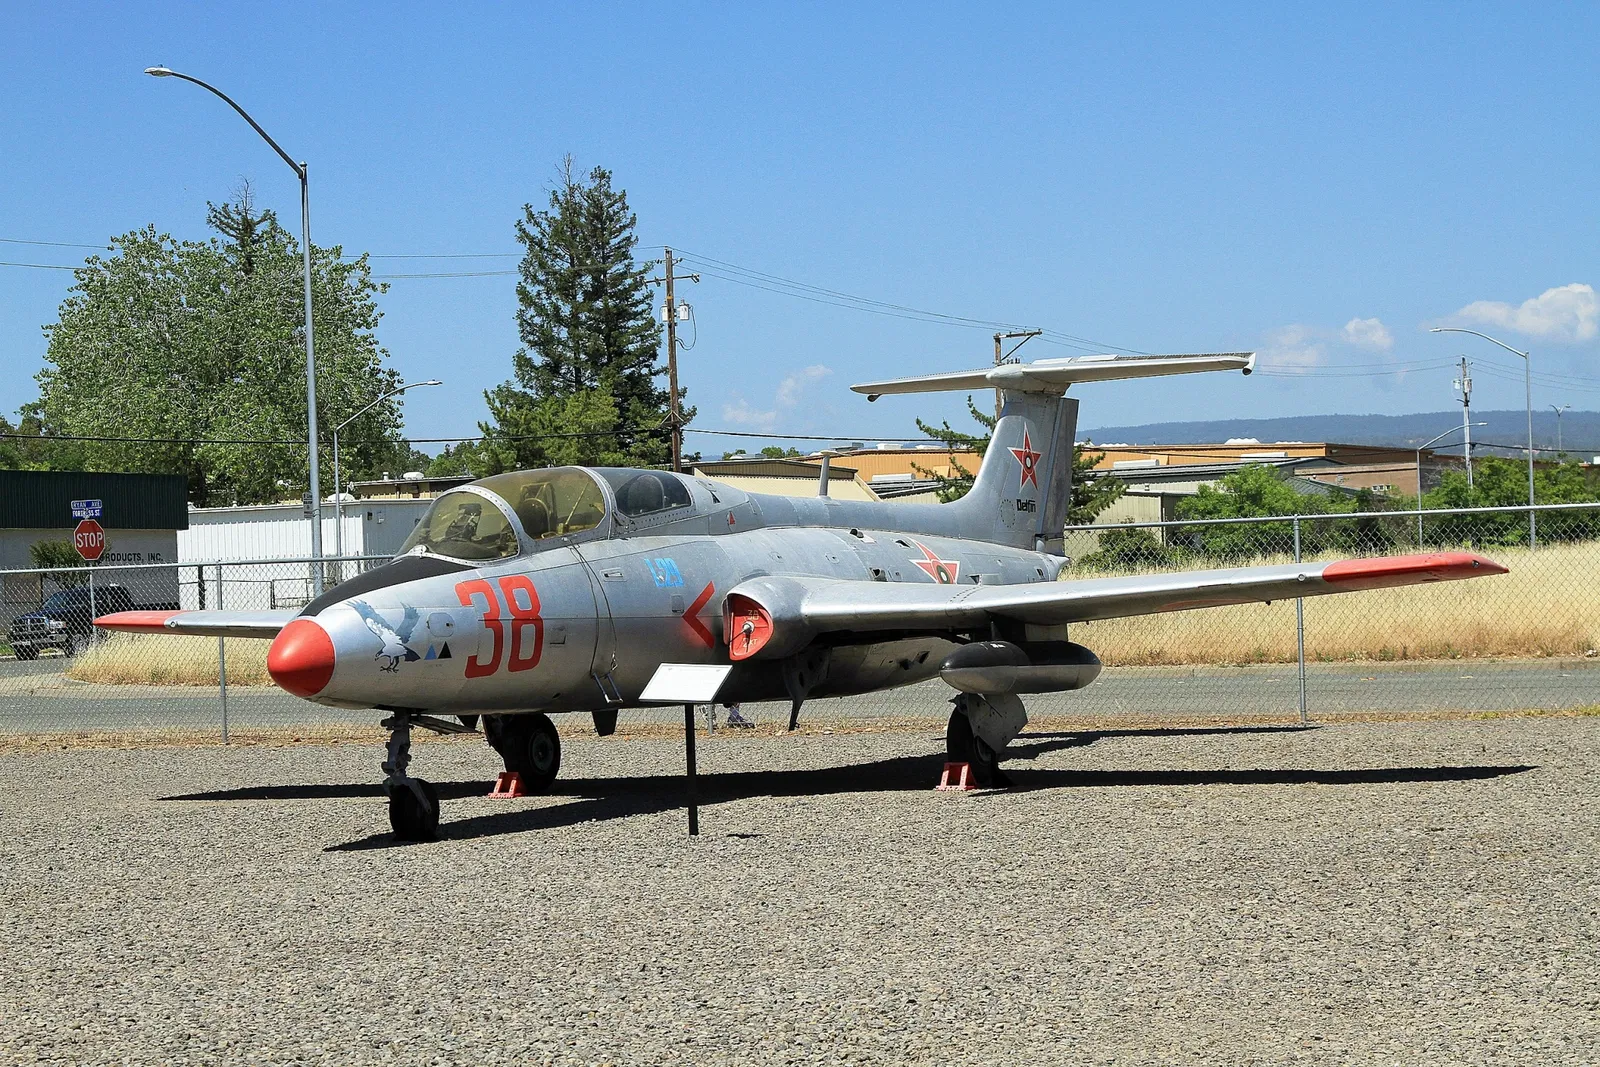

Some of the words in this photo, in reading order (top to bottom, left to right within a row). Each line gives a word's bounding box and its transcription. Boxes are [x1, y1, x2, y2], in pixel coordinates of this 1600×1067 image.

[72, 509, 94, 517] FORTRSS
[1016, 499, 1036, 513] Delfin
[76, 532, 103, 548] STOP
[147, 552, 164, 561] INC.
[454, 573, 544, 679] 38
